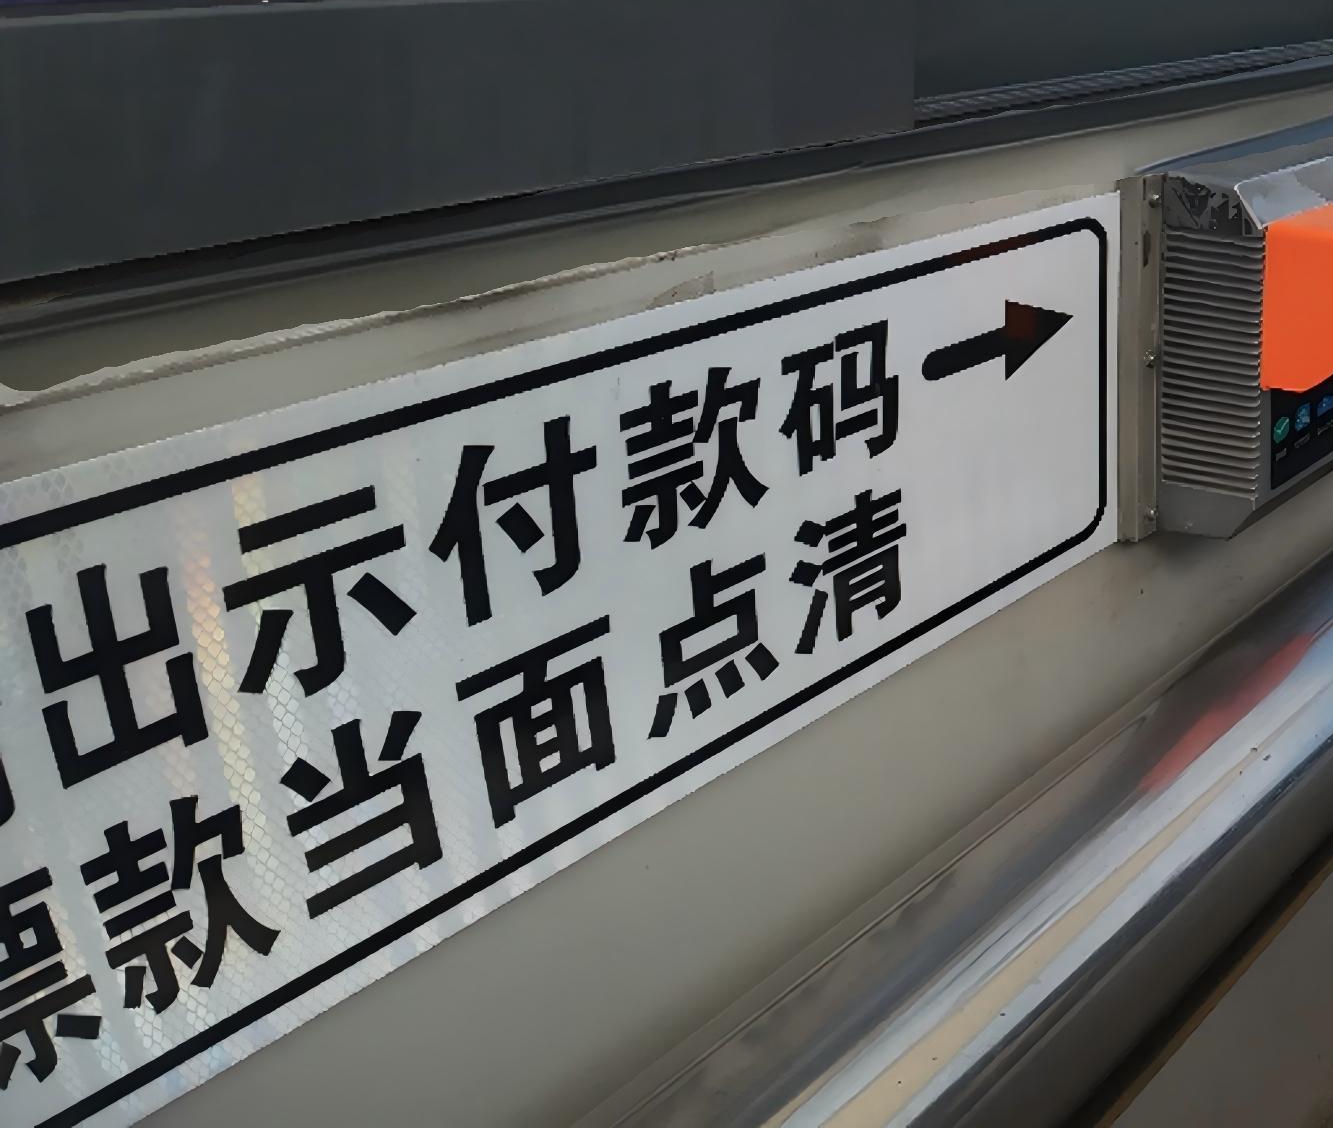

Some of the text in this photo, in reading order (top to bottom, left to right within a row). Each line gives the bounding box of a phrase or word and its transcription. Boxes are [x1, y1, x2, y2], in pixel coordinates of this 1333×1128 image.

[0, 320, 900, 827] 出示付款码
[0, 489, 908, 1086] 票款当面点清
